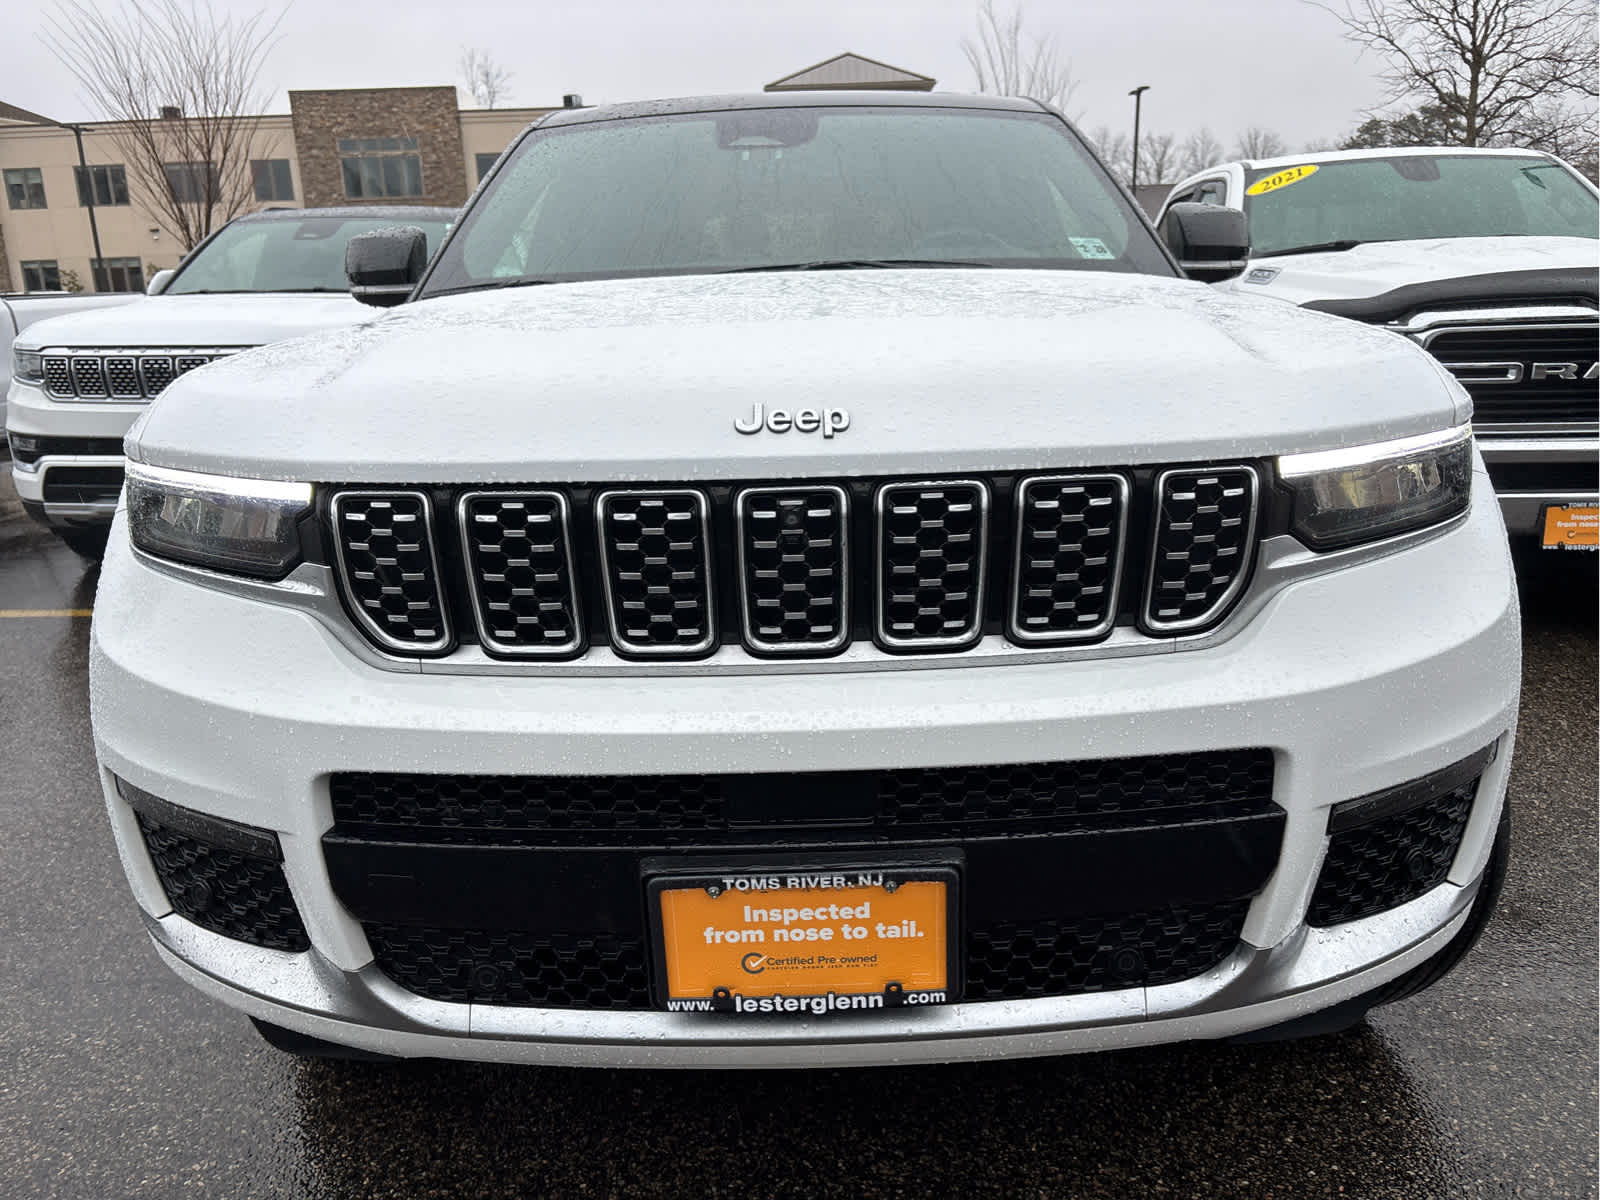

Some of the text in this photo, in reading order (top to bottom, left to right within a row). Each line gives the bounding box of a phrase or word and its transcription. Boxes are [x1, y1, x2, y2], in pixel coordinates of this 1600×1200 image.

[1262, 168, 1303, 191] 2021
[734, 401, 850, 439] Jeep
[722, 878, 780, 890] TOMS
[858, 873, 883, 886] NJ
[744, 902, 871, 925] Inspected
[703, 920, 924, 944] from nose to tail.
[766, 955, 814, 966] Certified
[667, 992, 946, 1015] www. lesterglenn .com
